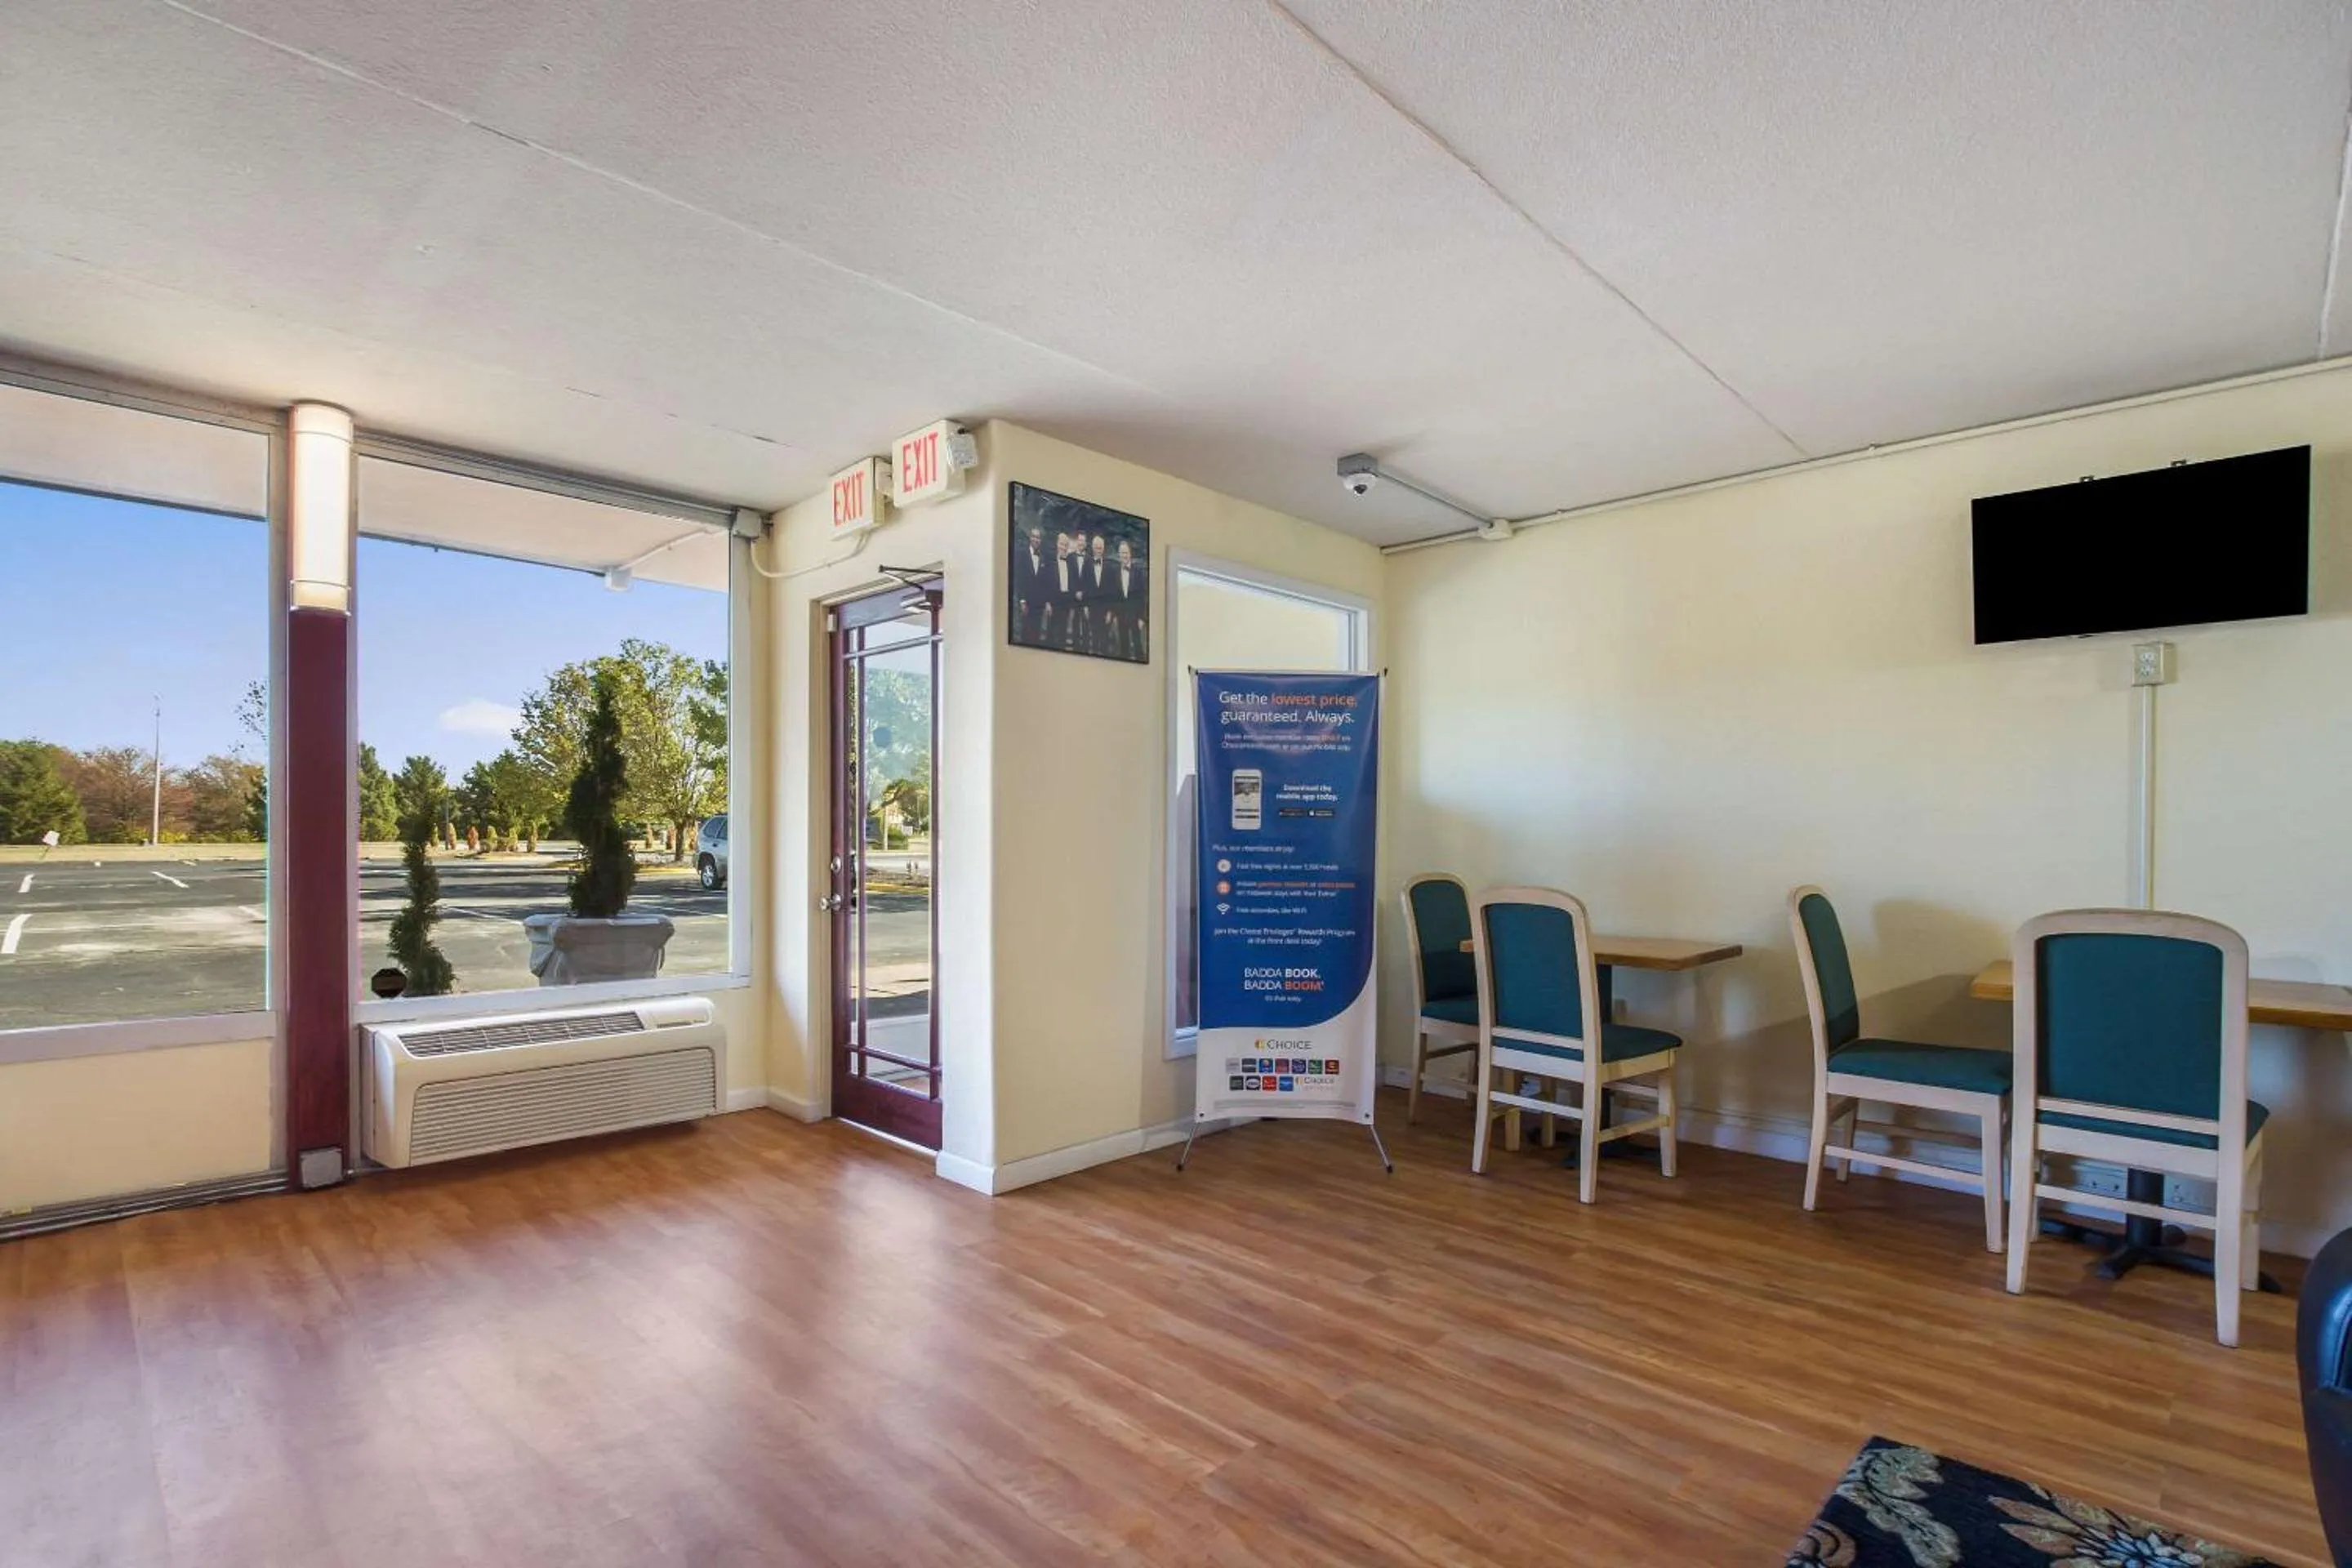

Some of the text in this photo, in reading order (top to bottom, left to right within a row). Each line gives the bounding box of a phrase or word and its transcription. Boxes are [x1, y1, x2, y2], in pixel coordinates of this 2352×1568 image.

[902, 432, 938, 493] EXIT
[833, 470, 865, 527] EXIT
[1219, 691, 1243, 705] Get
[1246, 692, 1267, 705] the
[1272, 692, 1316, 706] lowest
[1221, 710, 1355, 726] guaranteed. Always.
[1245, 968, 1282, 978] BADDA
[1245, 980, 1282, 990] BADDA
[1267, 1040, 1312, 1049] CHOICE
